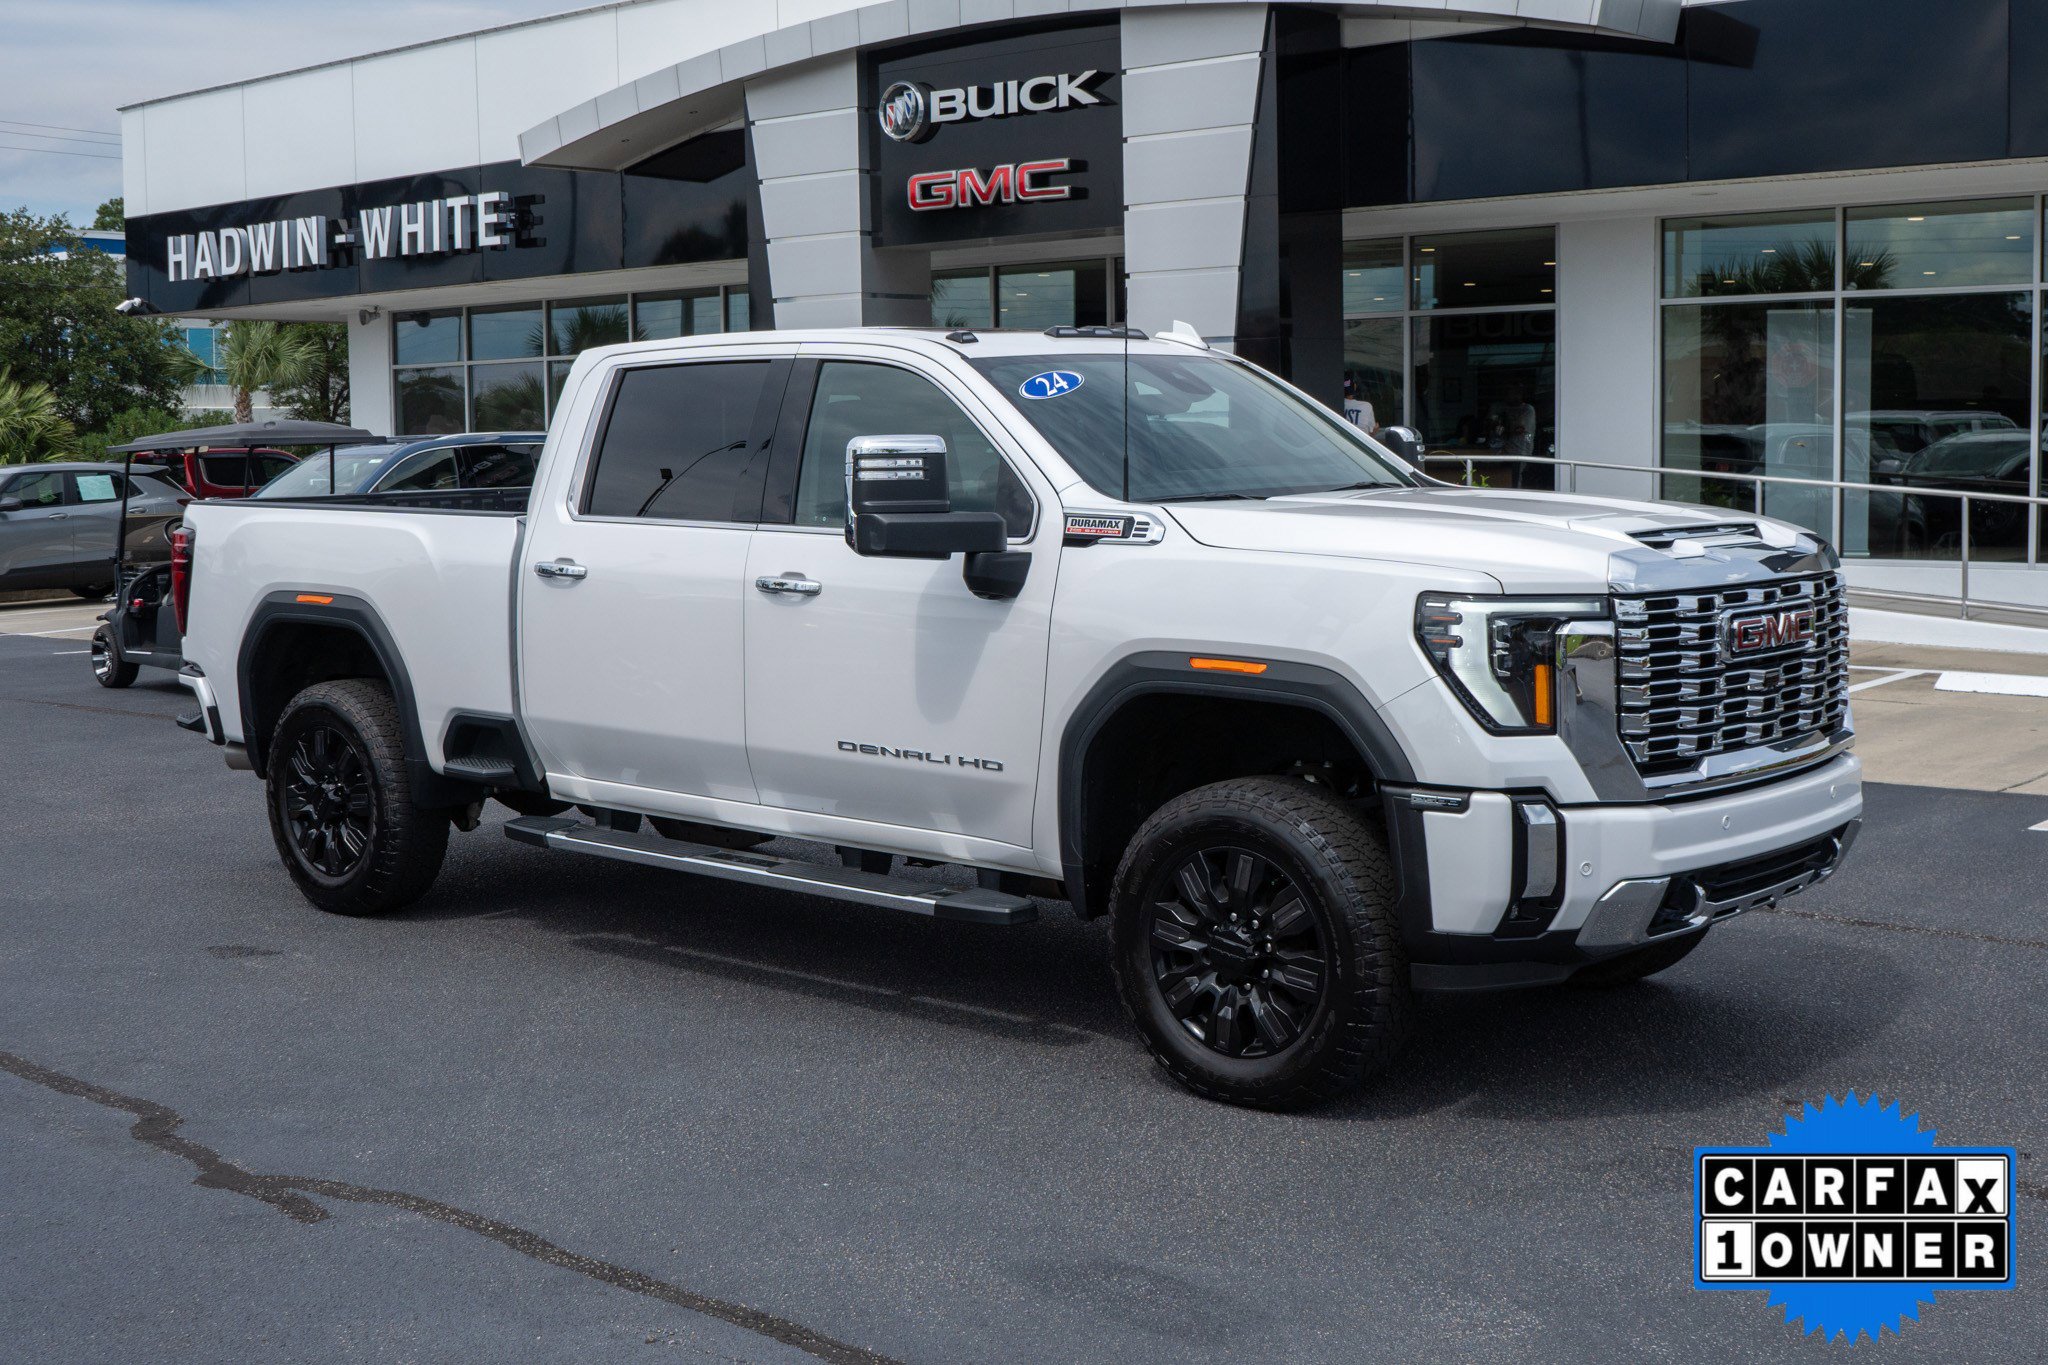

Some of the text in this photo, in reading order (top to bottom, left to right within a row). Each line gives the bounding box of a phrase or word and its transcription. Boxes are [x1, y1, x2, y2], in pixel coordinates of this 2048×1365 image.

[930, 69, 1100, 124] BUICK
[907, 158, 1072, 212] GMC
[1035, 372, 1069, 396] 24
[1344, 408, 1361, 425] ST
[1070, 518, 1121, 529] DURAMAX
[1733, 608, 1815, 652] GMC
[837, 740, 1003, 772] DENALI HD
